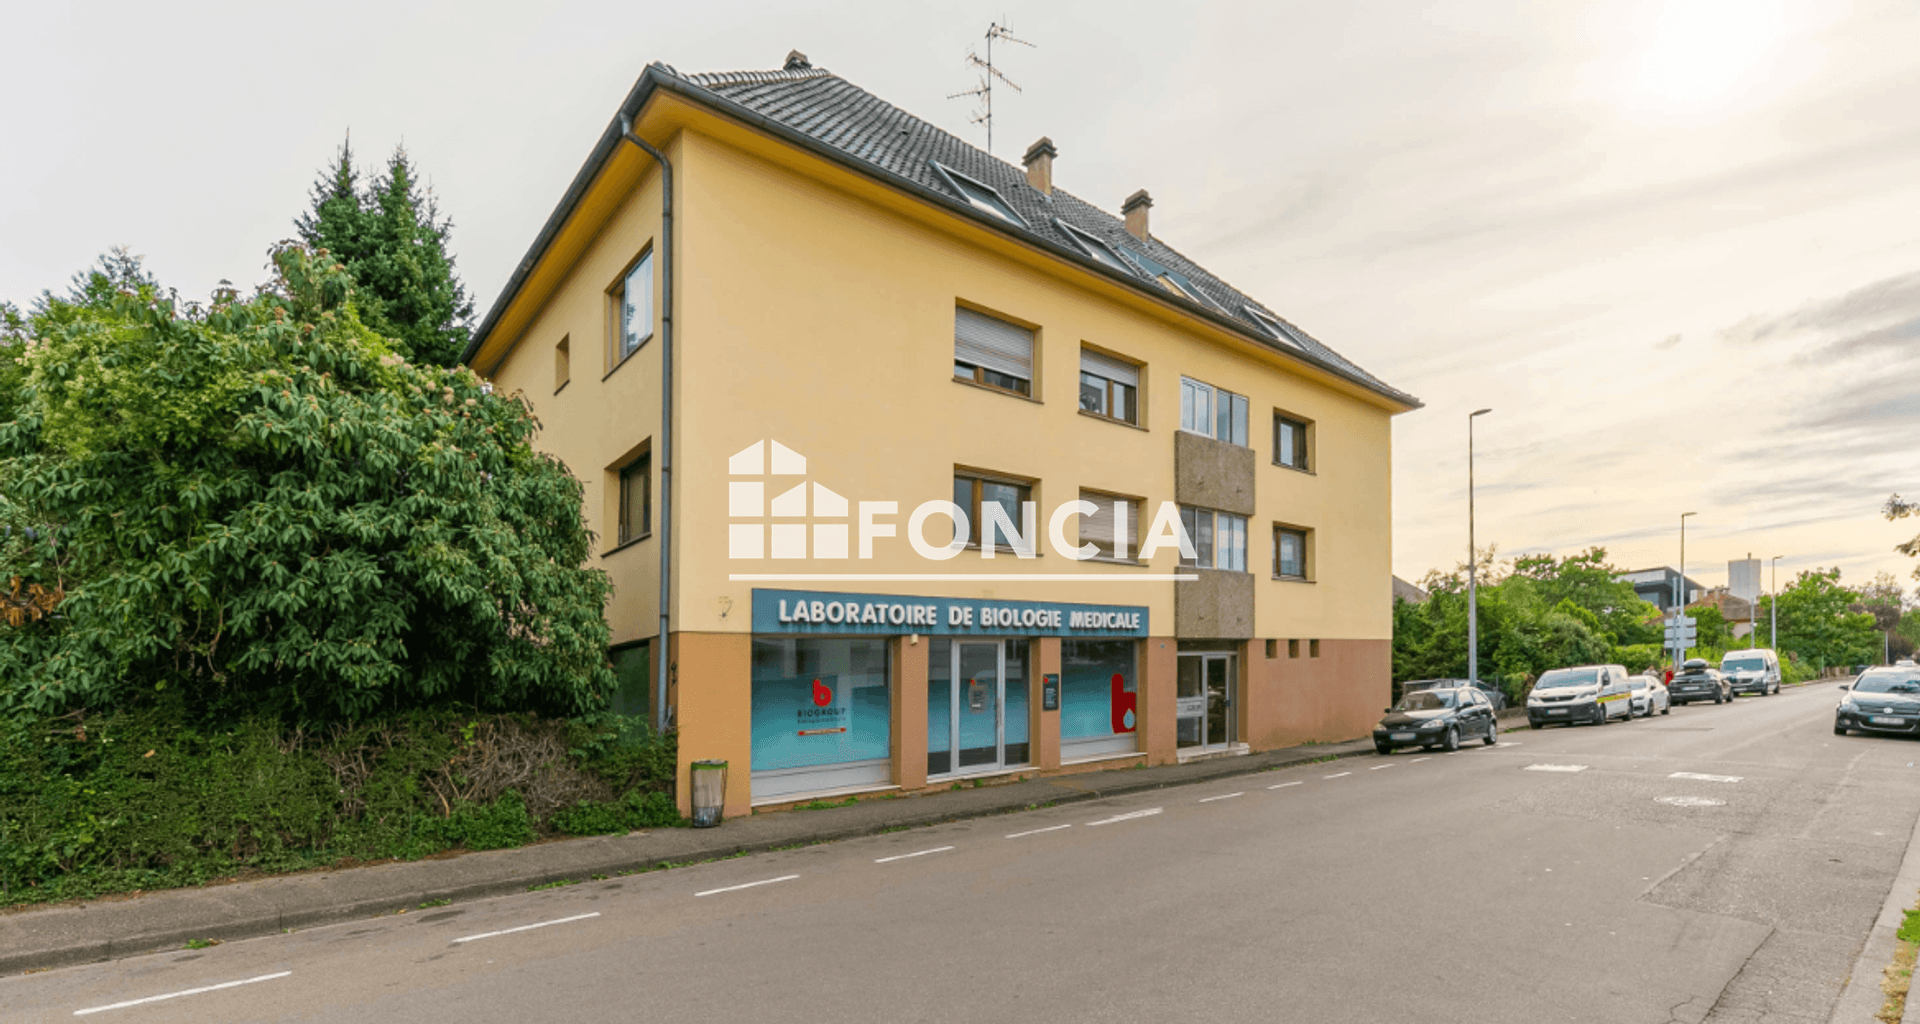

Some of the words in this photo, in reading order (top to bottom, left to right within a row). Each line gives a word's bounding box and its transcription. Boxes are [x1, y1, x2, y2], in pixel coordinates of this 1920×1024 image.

[778, 599, 938, 626] LABORATOIRE
[948, 605, 973, 627] DE
[979, 607, 1063, 628] BIOLOGIE
[1069, 610, 1141, 630] MEDICALE
